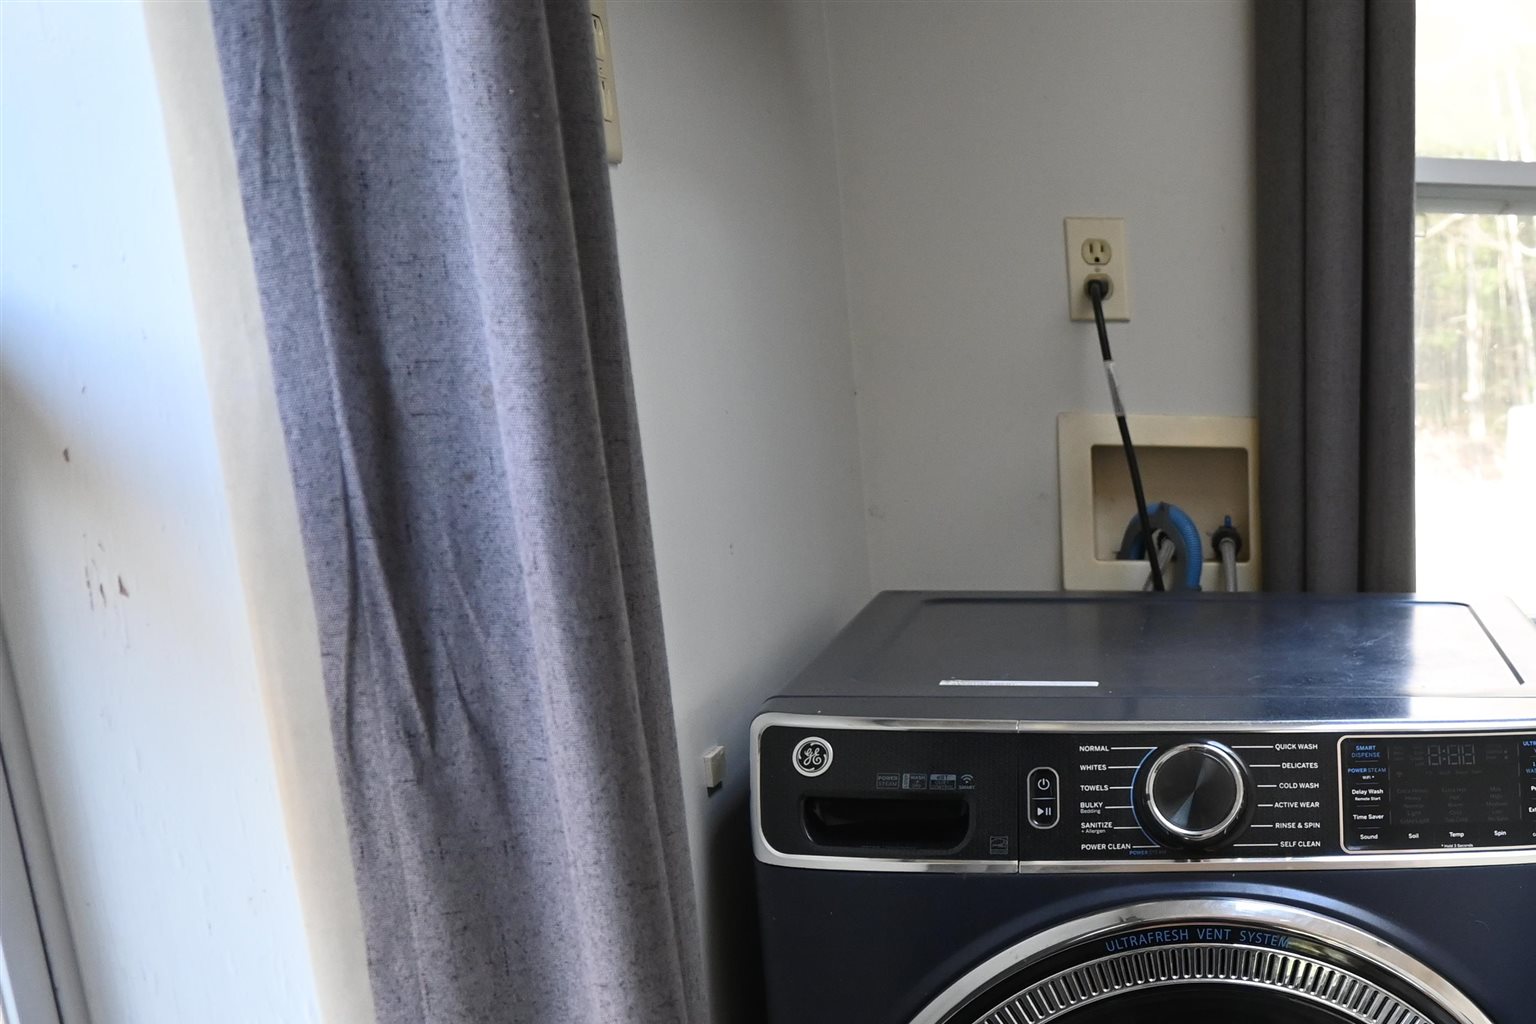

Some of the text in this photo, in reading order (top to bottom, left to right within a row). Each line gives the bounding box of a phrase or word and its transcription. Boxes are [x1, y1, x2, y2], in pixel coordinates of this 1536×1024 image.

[1106, 928, 1291, 952] ULTRAFRESH VENT SYSTEM
